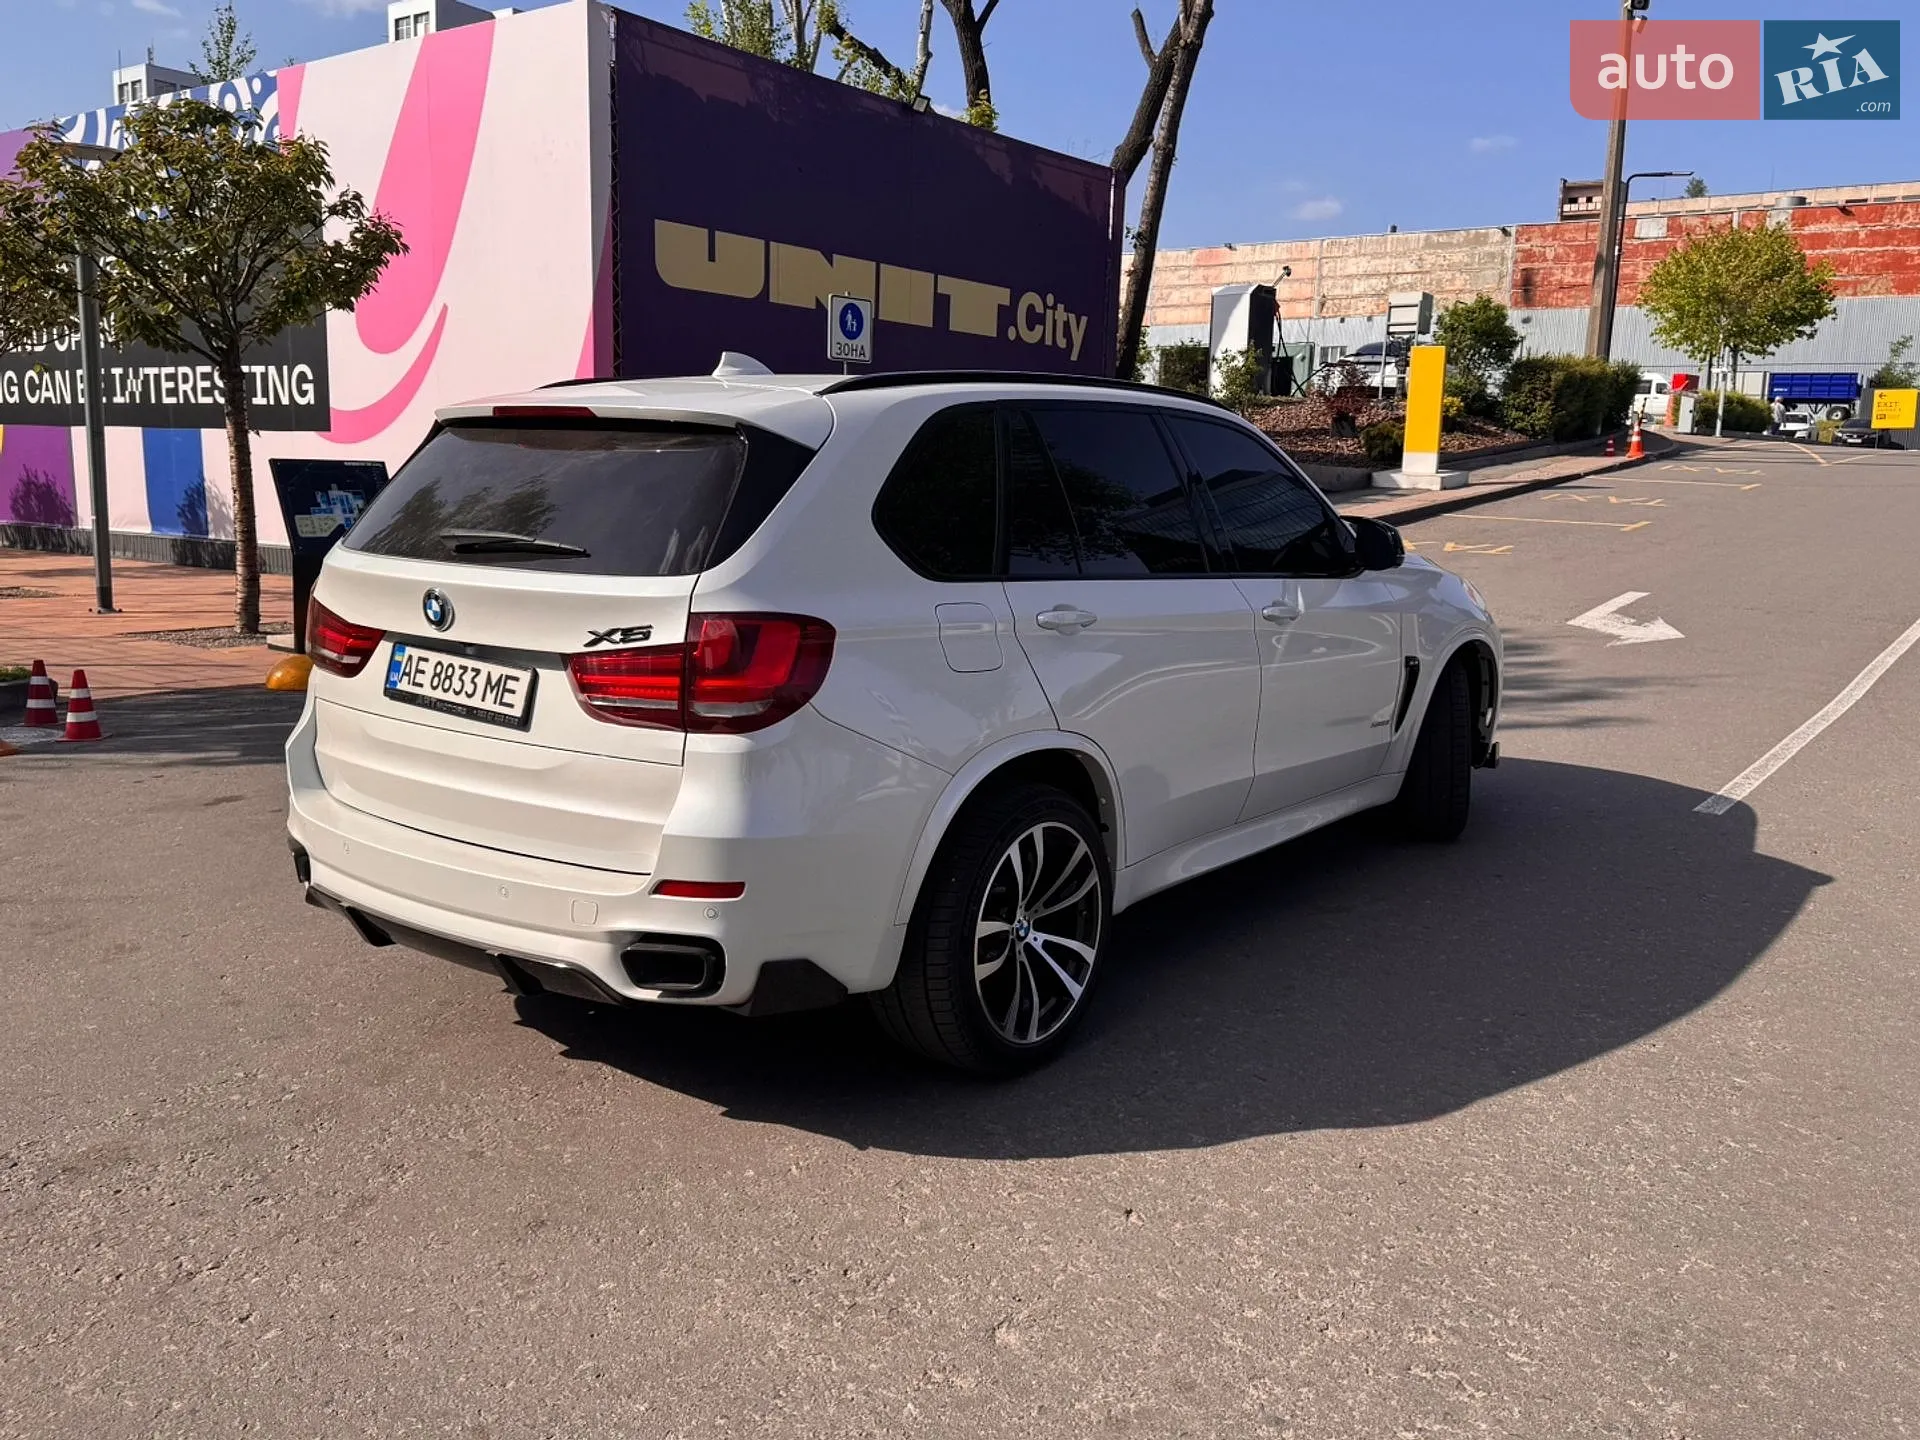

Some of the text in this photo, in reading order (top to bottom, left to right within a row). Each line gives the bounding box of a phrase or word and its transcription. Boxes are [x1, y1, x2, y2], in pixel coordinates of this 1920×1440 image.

[835, 342, 866, 358] ЗОНА
[24, 369, 72, 405] CAN
[583, 624, 654, 648] X5
[399, 653, 520, 709] AE 8833 ME
